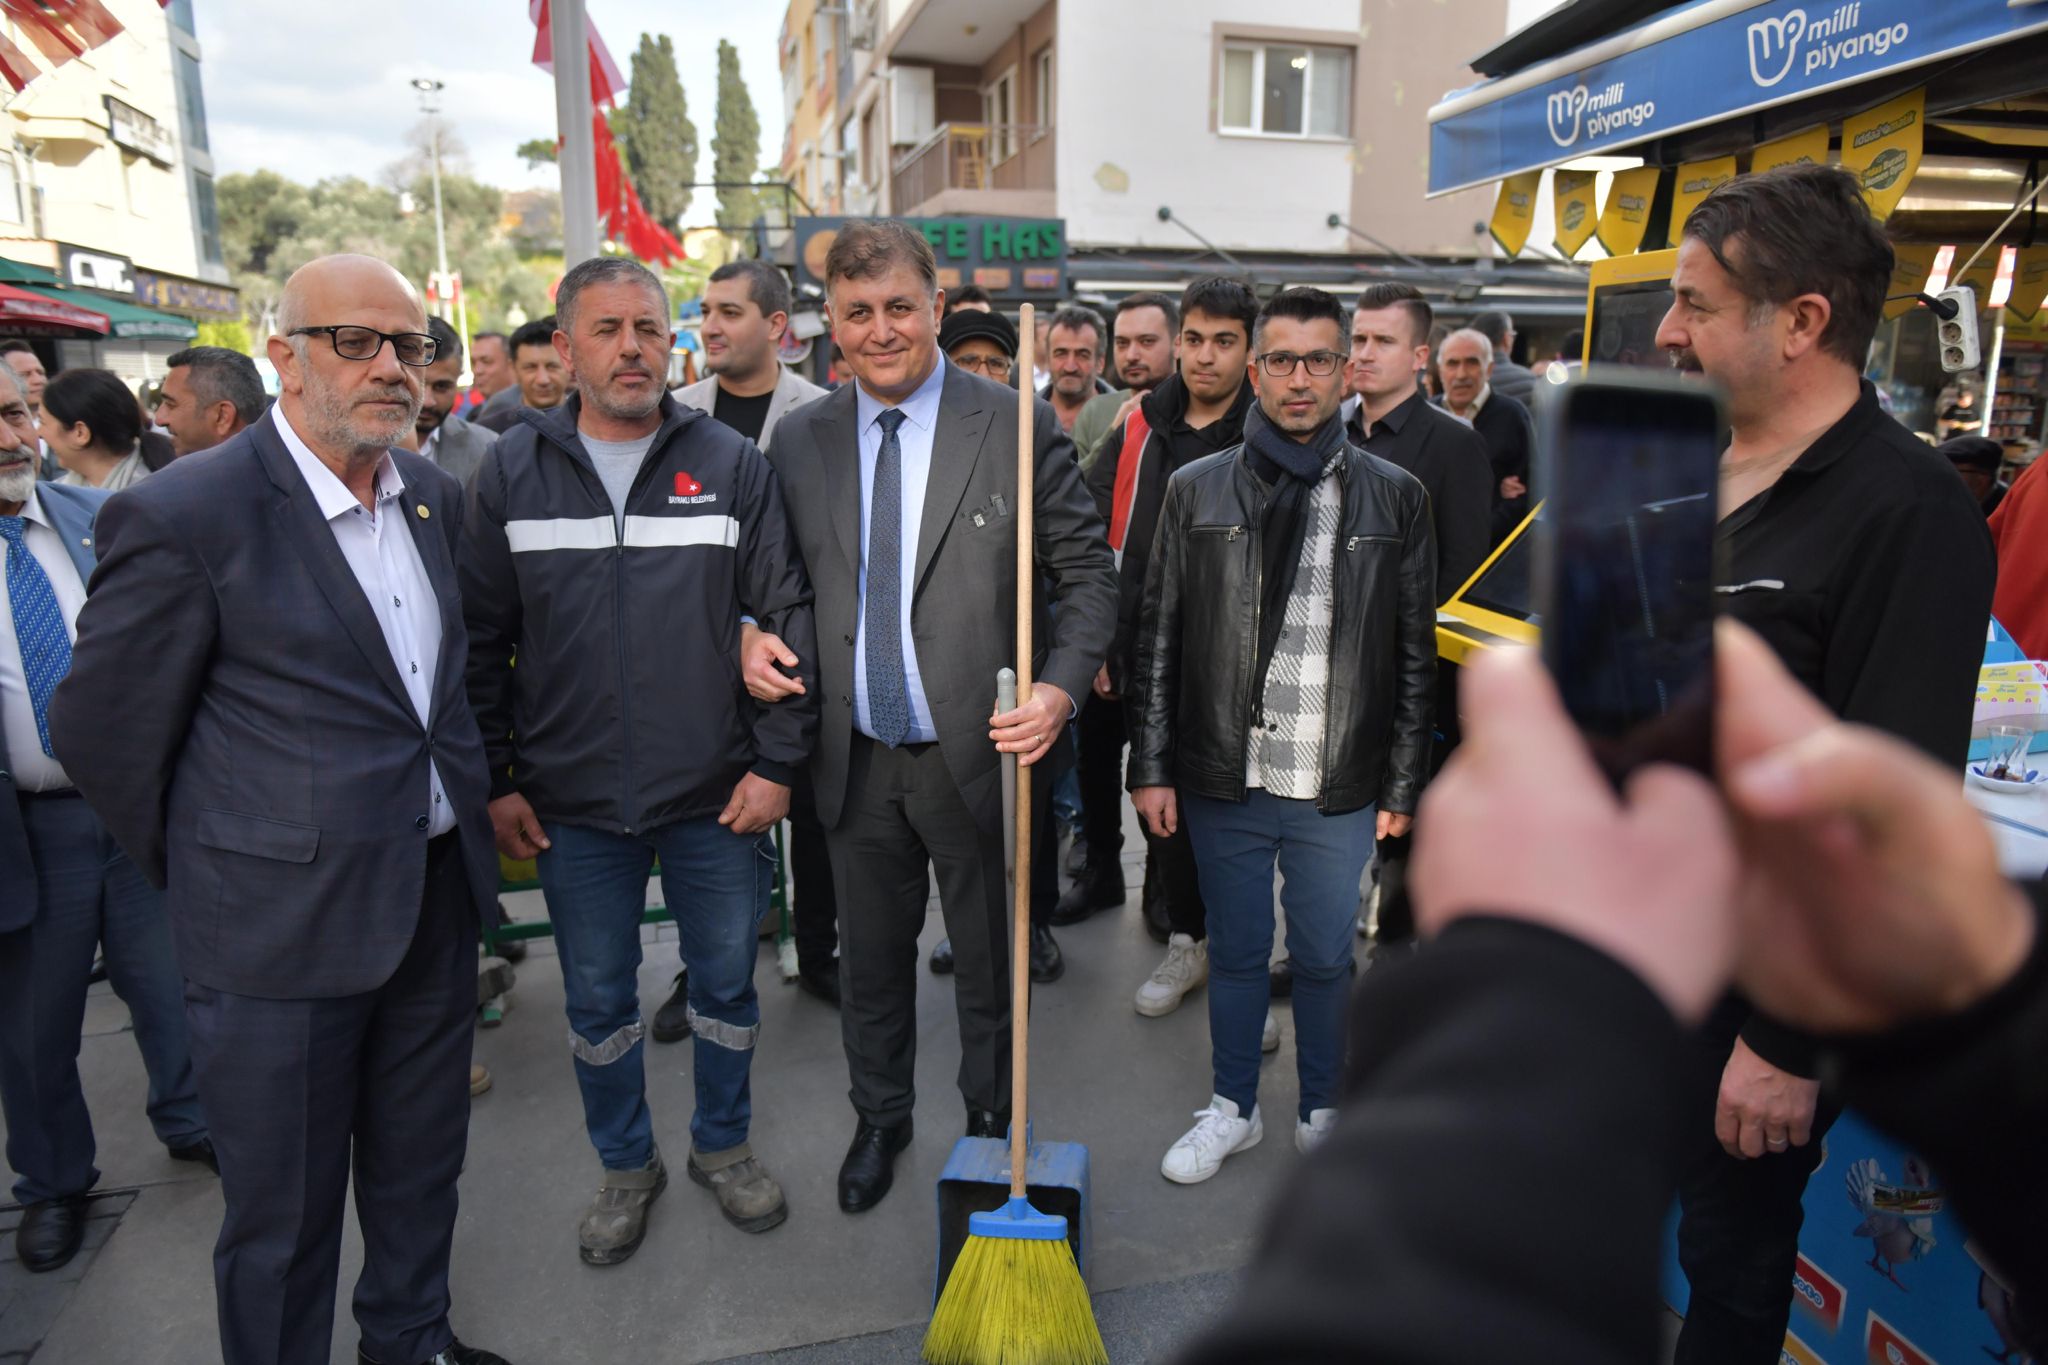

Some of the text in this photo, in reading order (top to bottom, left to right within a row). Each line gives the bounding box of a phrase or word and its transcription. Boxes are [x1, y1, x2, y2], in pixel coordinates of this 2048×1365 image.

[1808, 1, 1861, 42] milli
[1805, 22, 1909, 76] piyango
[1587, 82, 1624, 112] milli
[1587, 101, 1655, 139] piyango
[983, 222, 1062, 261] HAS
